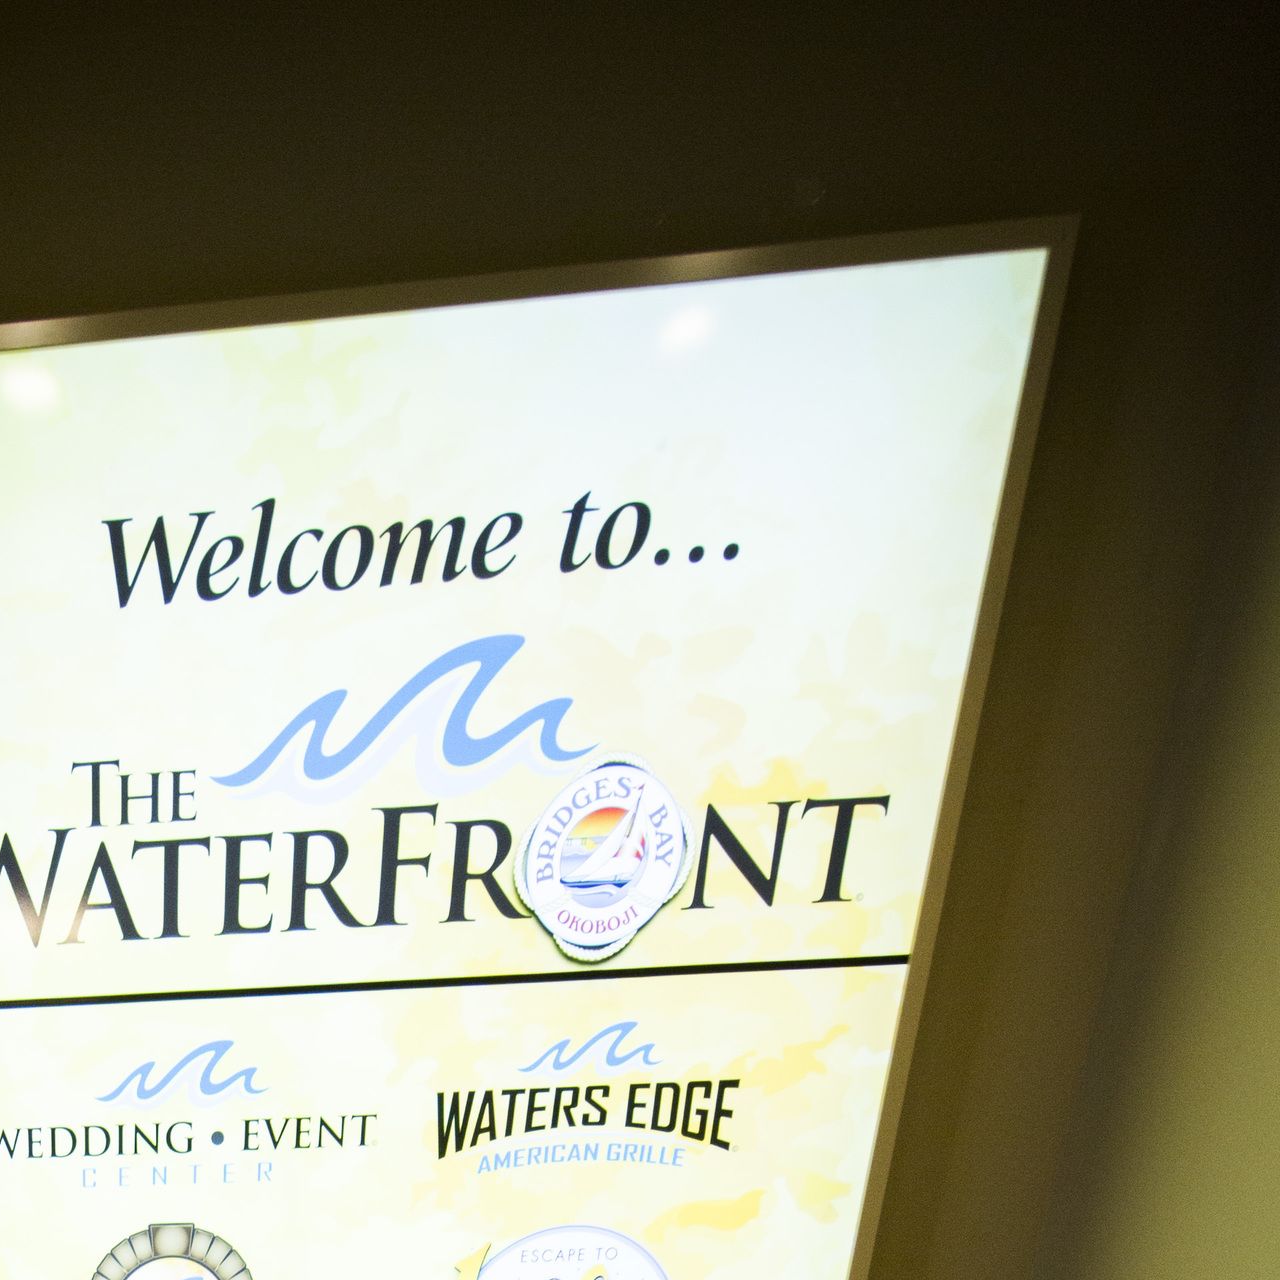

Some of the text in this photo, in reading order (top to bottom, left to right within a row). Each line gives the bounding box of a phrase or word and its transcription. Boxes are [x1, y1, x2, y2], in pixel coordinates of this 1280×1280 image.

[101, 490, 741, 609] Welcome to...
[71, 758, 198, 829] THE
[536, 776, 674, 884] BRIDGES BAY
[557, 905, 639, 935] OKOBOJI
[242, 1114, 378, 1152] EVENT
[437, 1079, 741, 1160] WATERS EDGE
[82, 1162, 273, 1189] CENTER
[477, 1143, 687, 1174] AMERICAN GRILLE
[521, 1247, 618, 1263] ESCAPE TO
